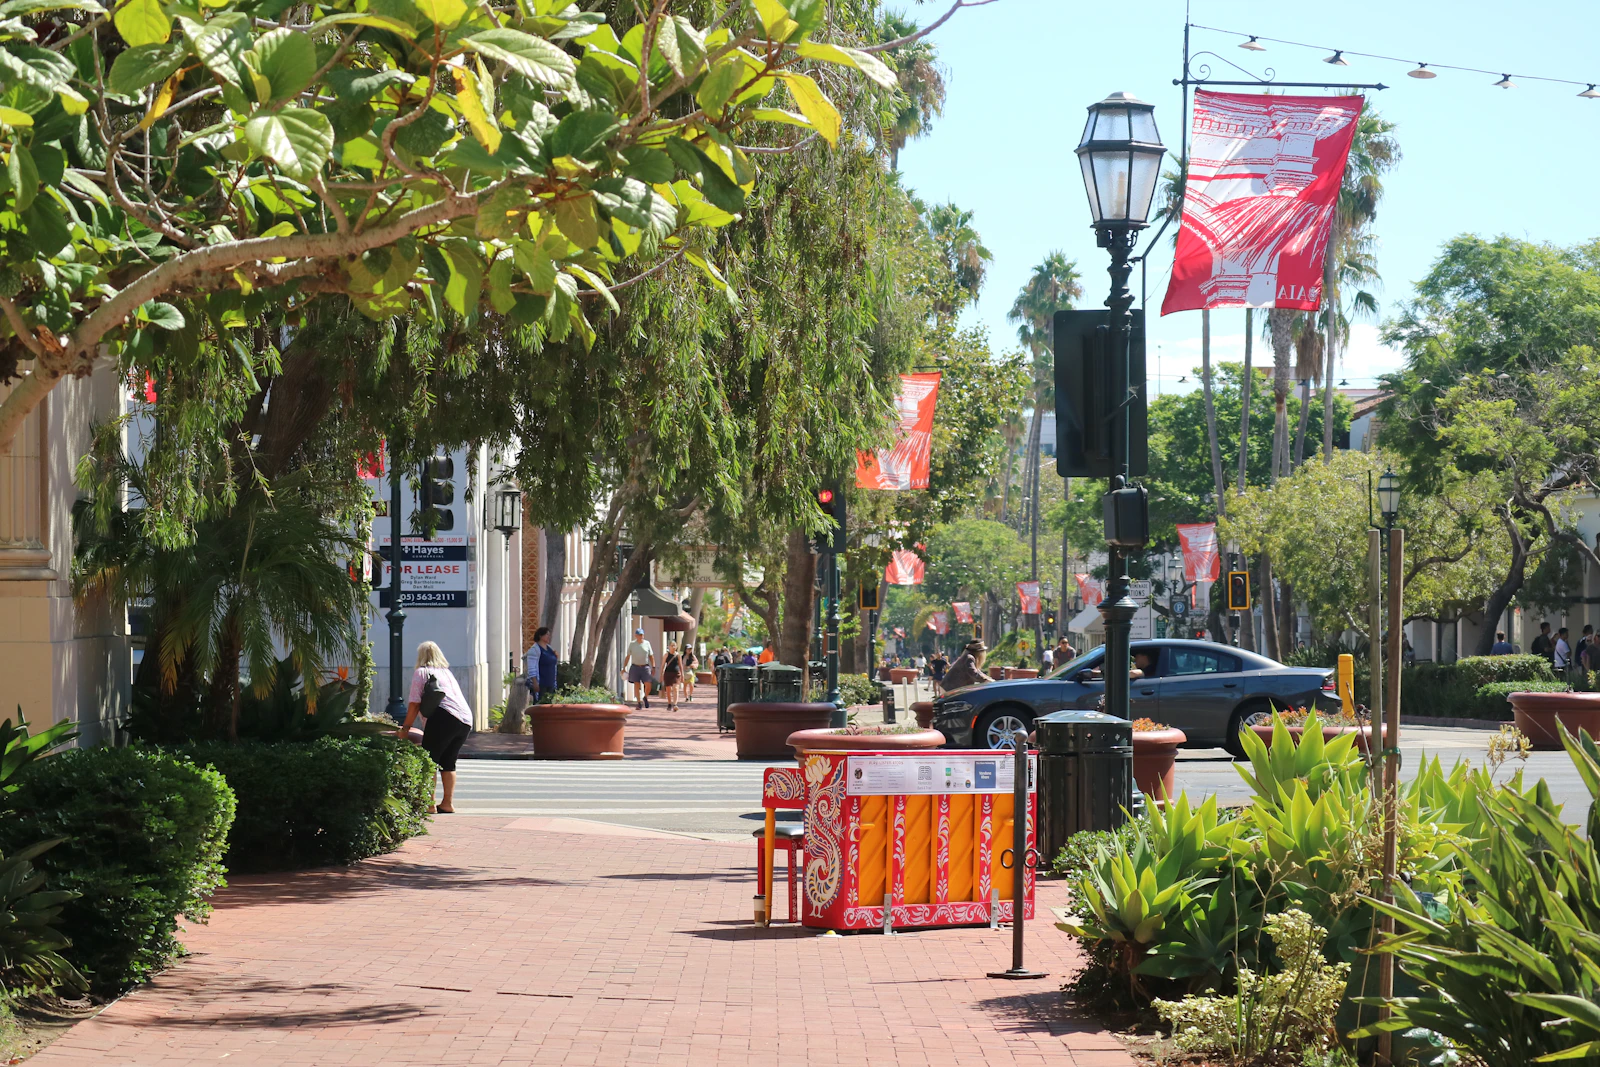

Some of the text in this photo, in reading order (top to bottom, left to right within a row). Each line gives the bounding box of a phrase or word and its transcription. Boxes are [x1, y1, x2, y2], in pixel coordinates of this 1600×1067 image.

[412, 546, 444, 555] Hayes
[386, 565, 412, 574] FR
[417, 565, 460, 574] LEASE
[416, 593, 455, 601] 563-2111
